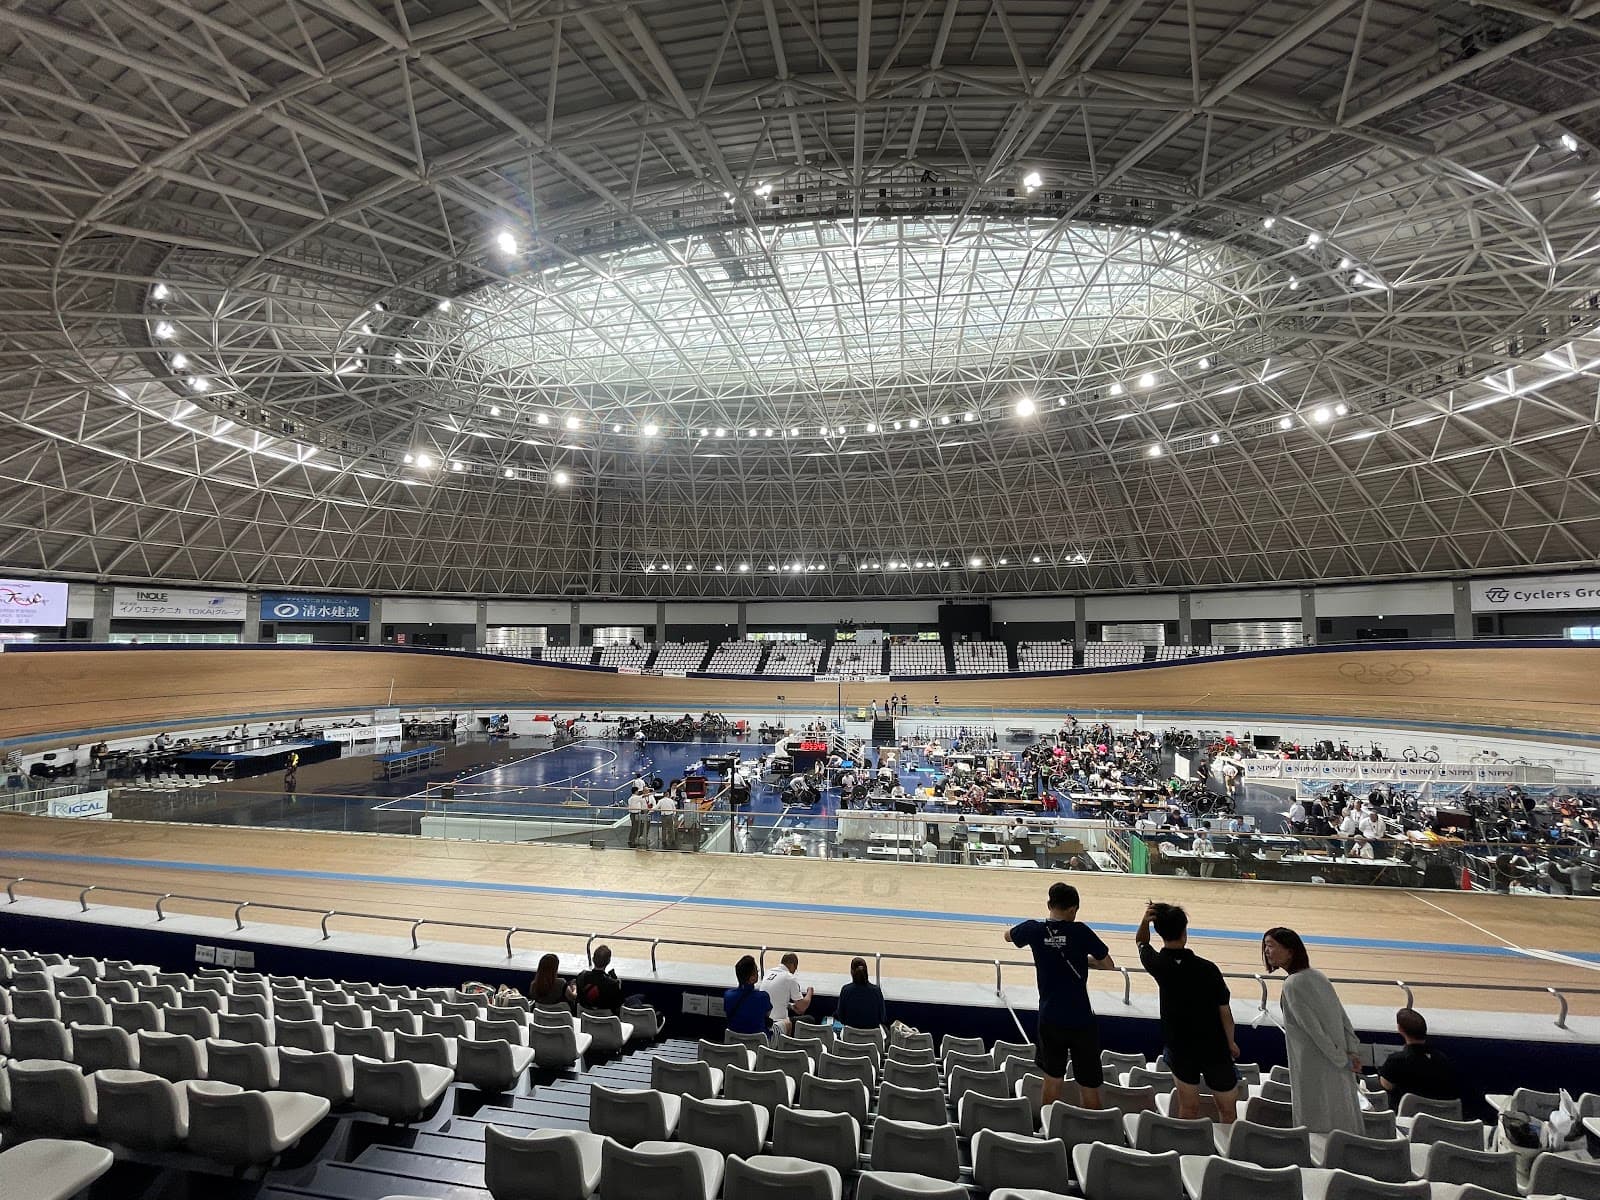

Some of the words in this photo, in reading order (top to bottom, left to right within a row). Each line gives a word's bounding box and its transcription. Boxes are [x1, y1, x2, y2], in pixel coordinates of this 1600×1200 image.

[1513, 589, 1571, 602] Cyclers
[302, 604, 360, 618] 清水建設
